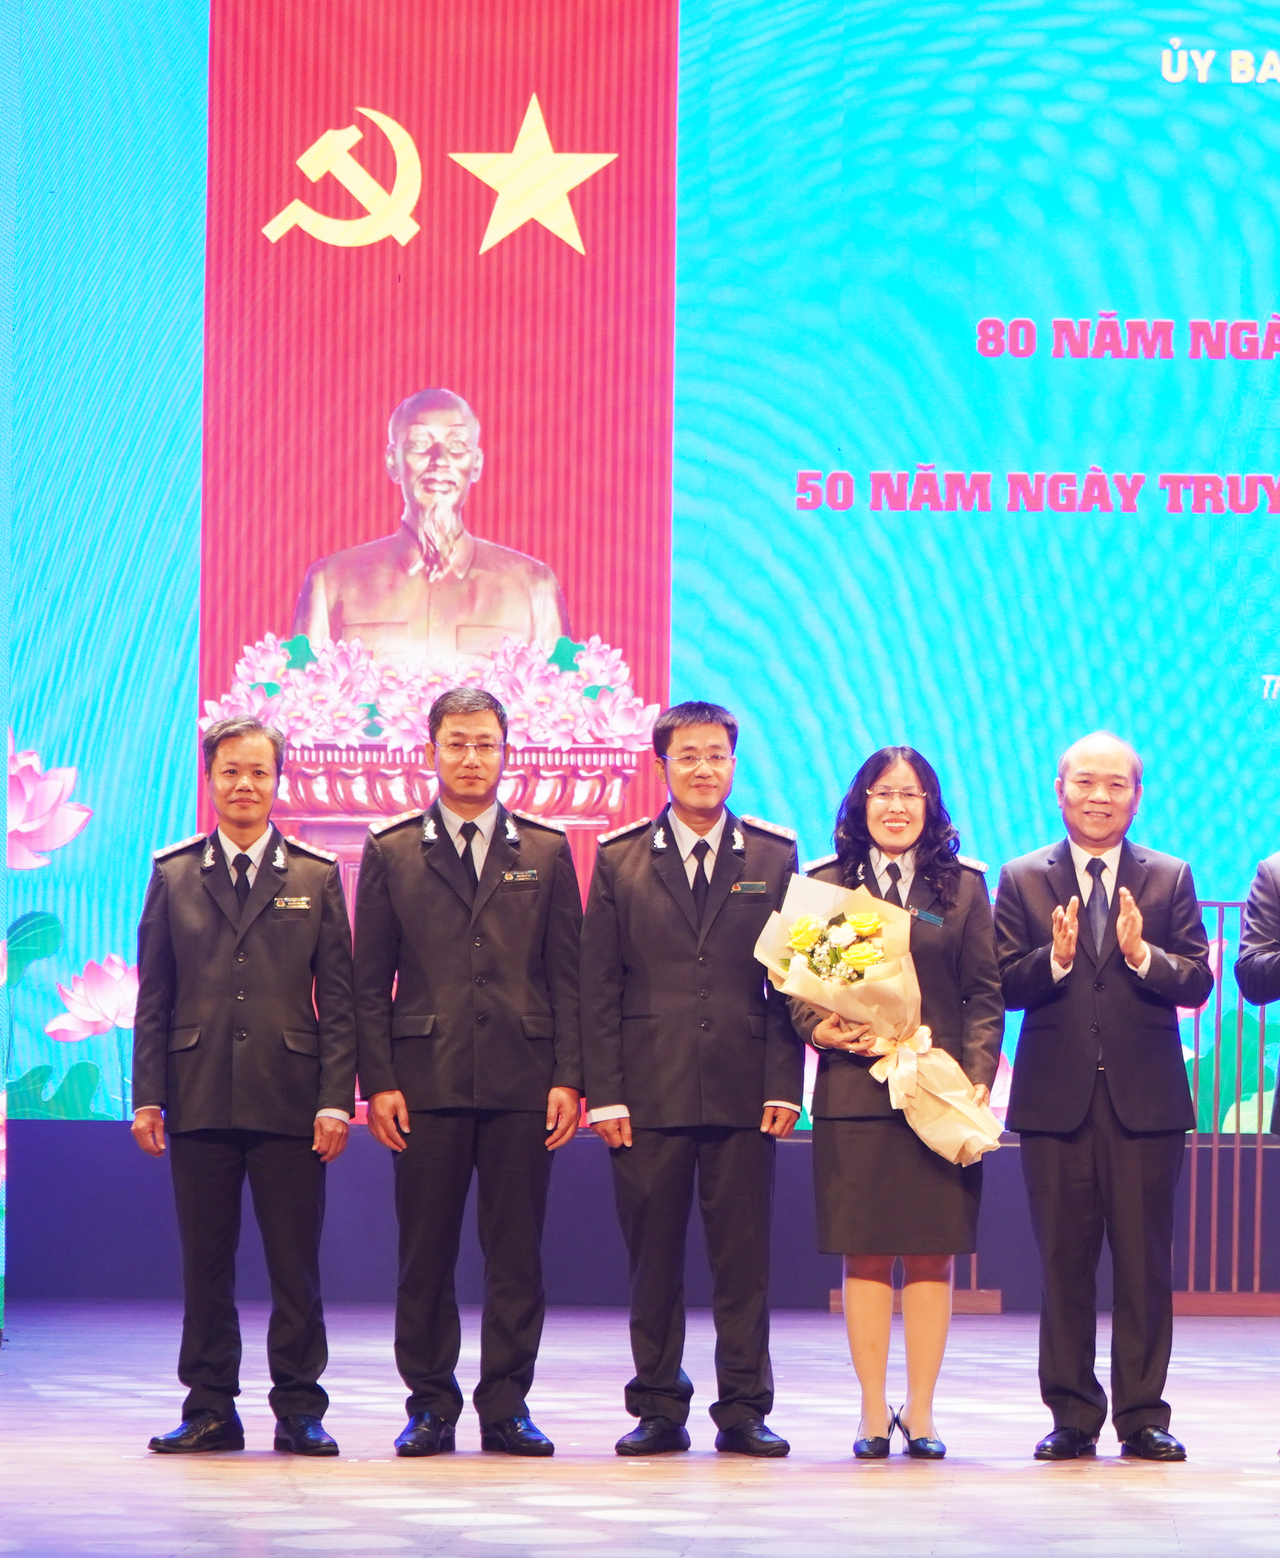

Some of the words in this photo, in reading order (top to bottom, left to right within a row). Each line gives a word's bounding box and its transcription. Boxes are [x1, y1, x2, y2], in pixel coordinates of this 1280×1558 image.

[1161, 37, 1216, 83] ỦY
[978, 319, 1036, 358] 80
[1052, 311, 1174, 359] NĂM
[796, 472, 854, 510] 50
[870, 464, 991, 512] NĂM
[1007, 466, 1145, 512] NGÀY
